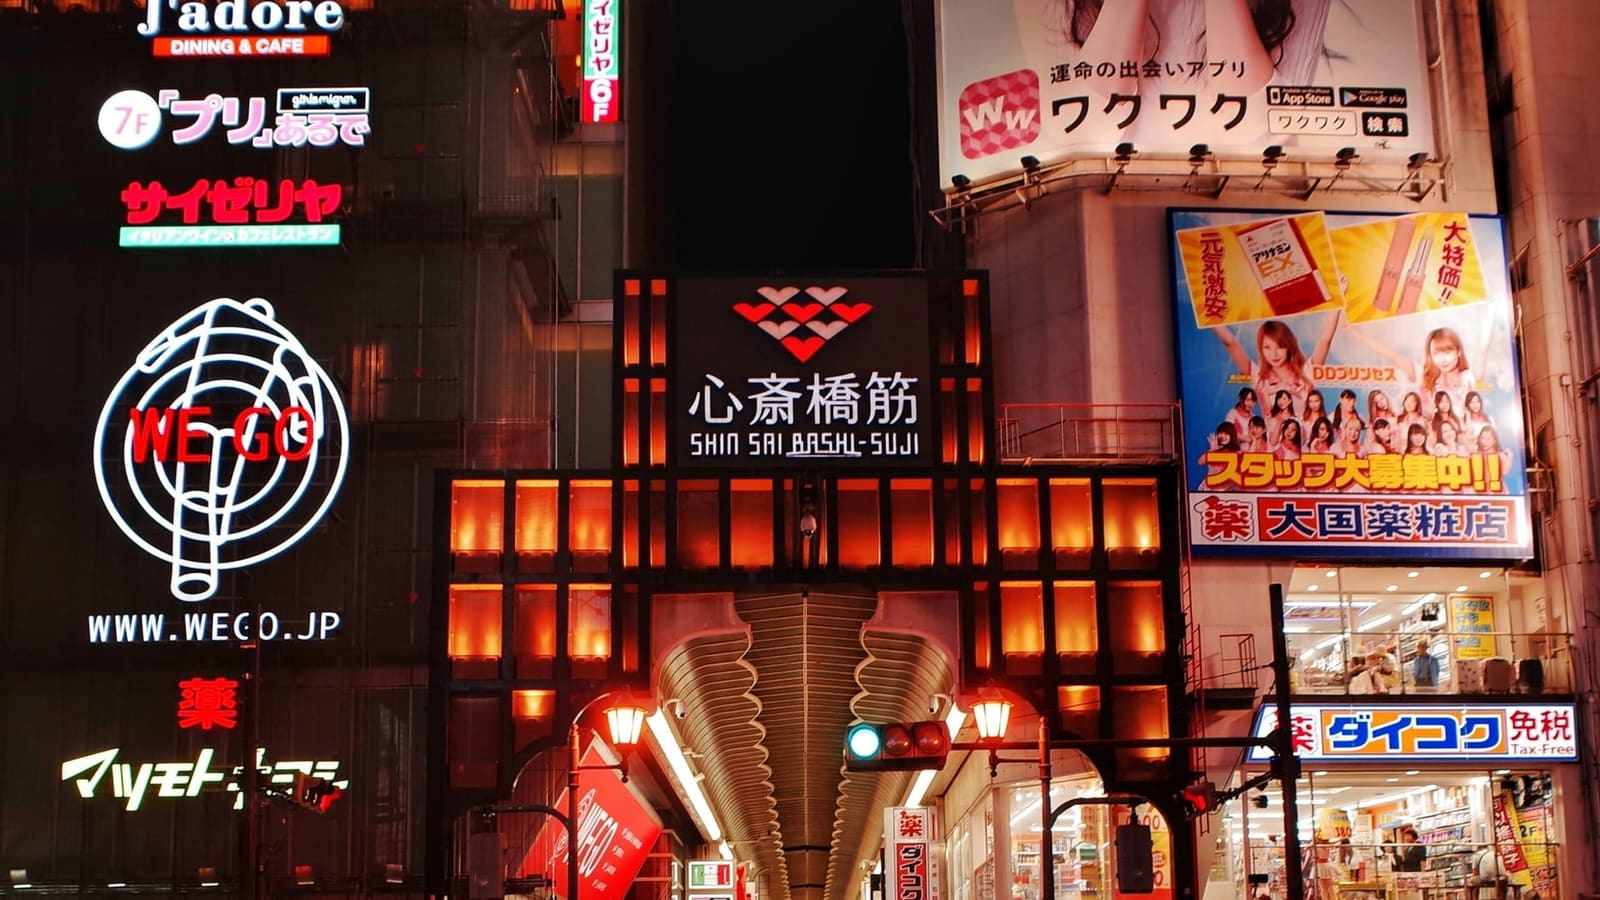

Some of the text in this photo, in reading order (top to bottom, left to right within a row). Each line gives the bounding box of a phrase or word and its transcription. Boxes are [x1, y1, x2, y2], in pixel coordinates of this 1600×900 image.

[170, 38, 304, 55] DINING & CAFE
[1050, 60, 1246, 85] 運命の出会いアプリ
[590, 79, 612, 122] 6F
[1052, 93, 1247, 134] ワクワク
[114, 106, 149, 135] 7F
[1278, 115, 1346, 131] ワクワク
[121, 177, 341, 224] サイゼリヤ
[1200, 232, 1227, 319] 元気激安
[1312, 366, 1397, 381] DDプリンセス
[688, 371, 919, 426] 心斎橋筋
[691, 432, 739, 456] SHIN
[749, 432, 782, 456] SAI
[1203, 496, 1509, 541] 薬 大国薬粧店
[177, 677, 239, 730] 薬
[1328, 714, 1501, 750] ダイコク
[1510, 709, 1572, 742] 免税
[1510, 743, 1574, 756] Tax-Free
[900, 811, 922, 837] 薬
